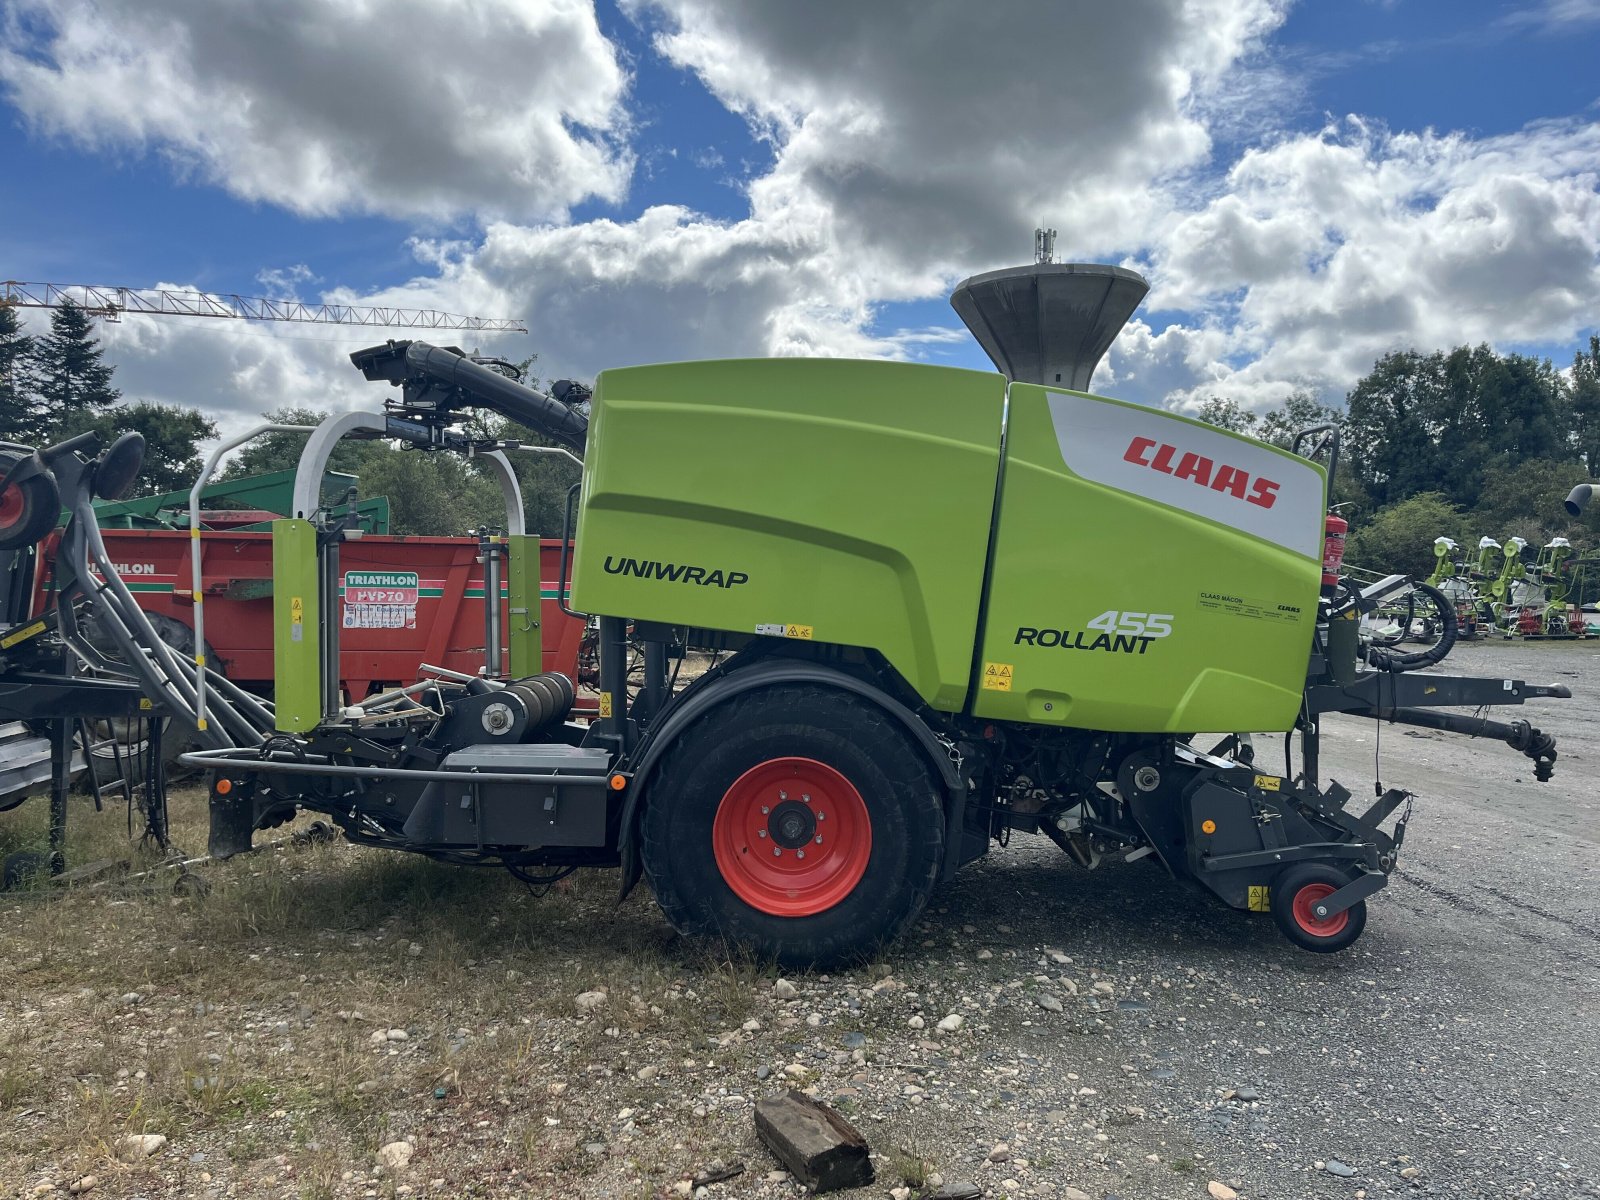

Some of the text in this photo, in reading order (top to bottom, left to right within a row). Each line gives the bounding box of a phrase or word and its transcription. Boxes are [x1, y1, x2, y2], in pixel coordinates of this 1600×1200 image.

[1123, 436, 1281, 509] CLAAS
[348, 575, 416, 585] TRIATHLON
[603, 556, 749, 588] UNIWRAP
[1200, 592, 1221, 600] CLAAS
[1277, 604, 1300, 613] CLAAS
[1086, 610, 1174, 638] 455
[1014, 627, 1155, 654] ROLLANT
